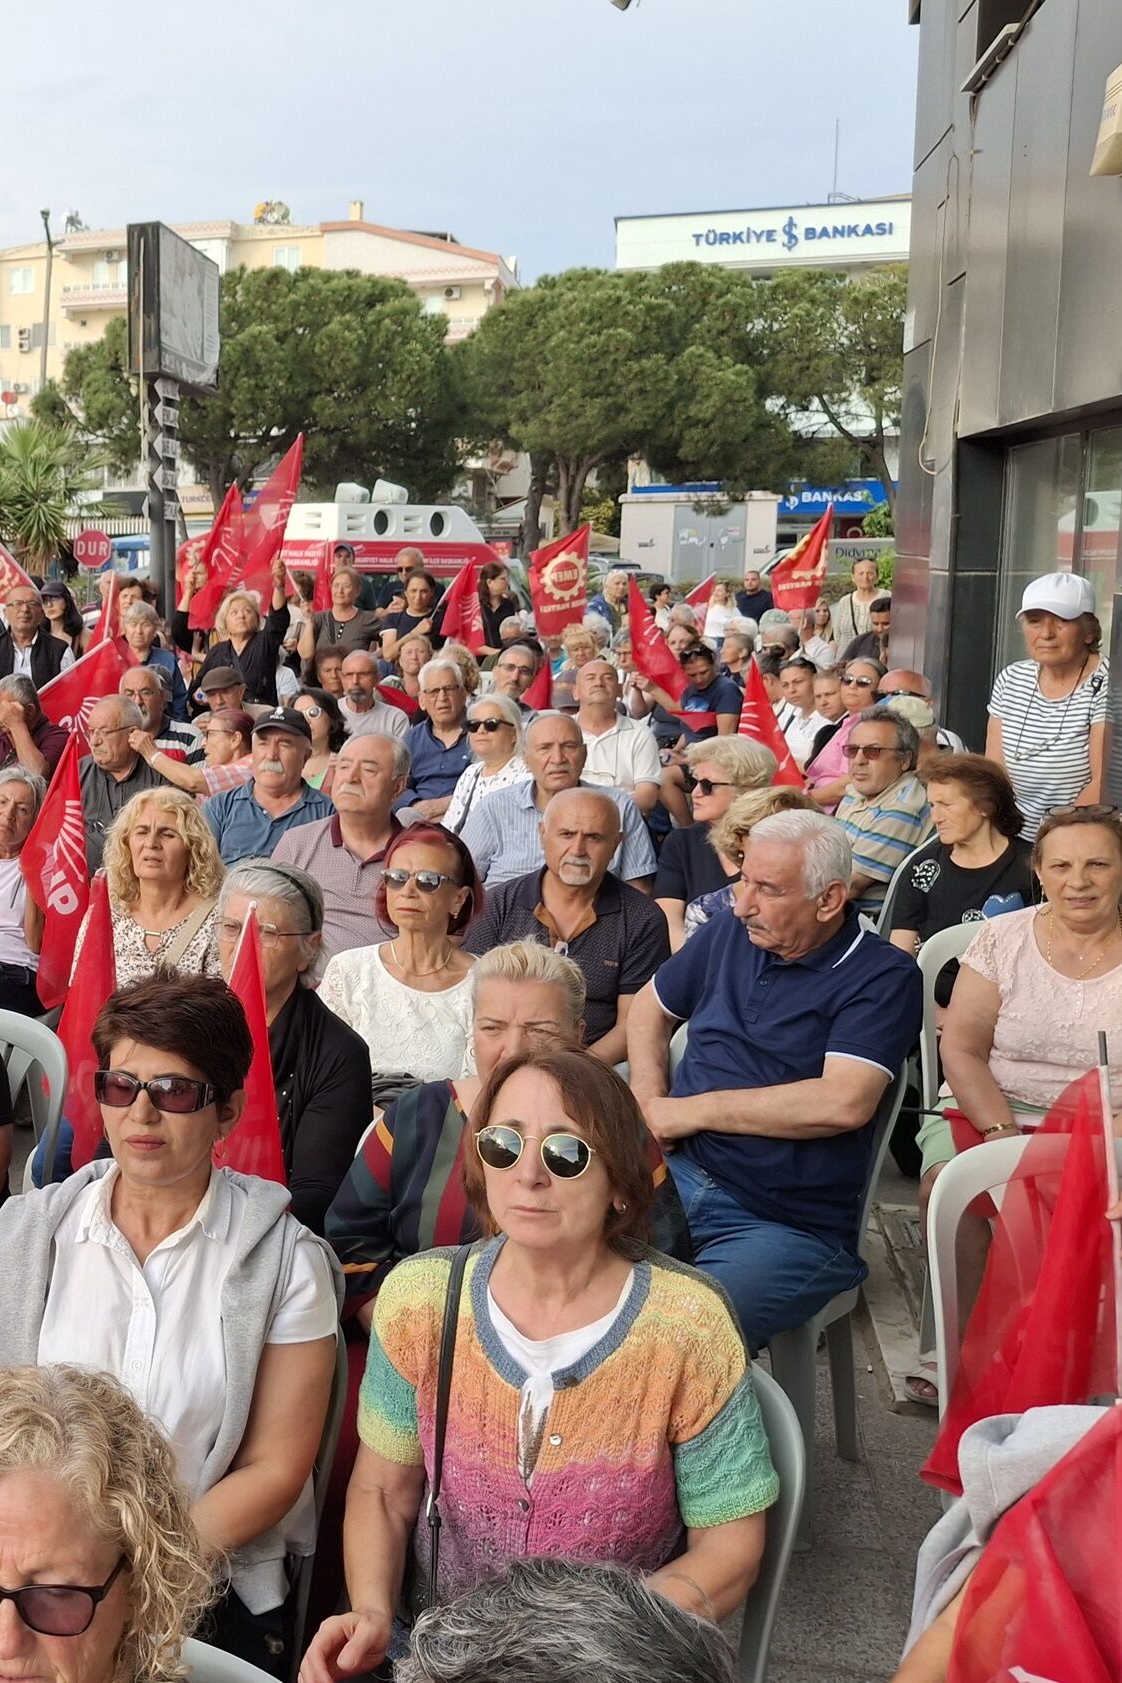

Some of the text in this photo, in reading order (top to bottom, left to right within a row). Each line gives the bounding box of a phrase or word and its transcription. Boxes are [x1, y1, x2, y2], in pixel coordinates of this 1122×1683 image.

[692, 226, 777, 246] TÜRKİYE
[804, 221, 893, 240] BANKASI
[77, 541, 108, 556] DUR
